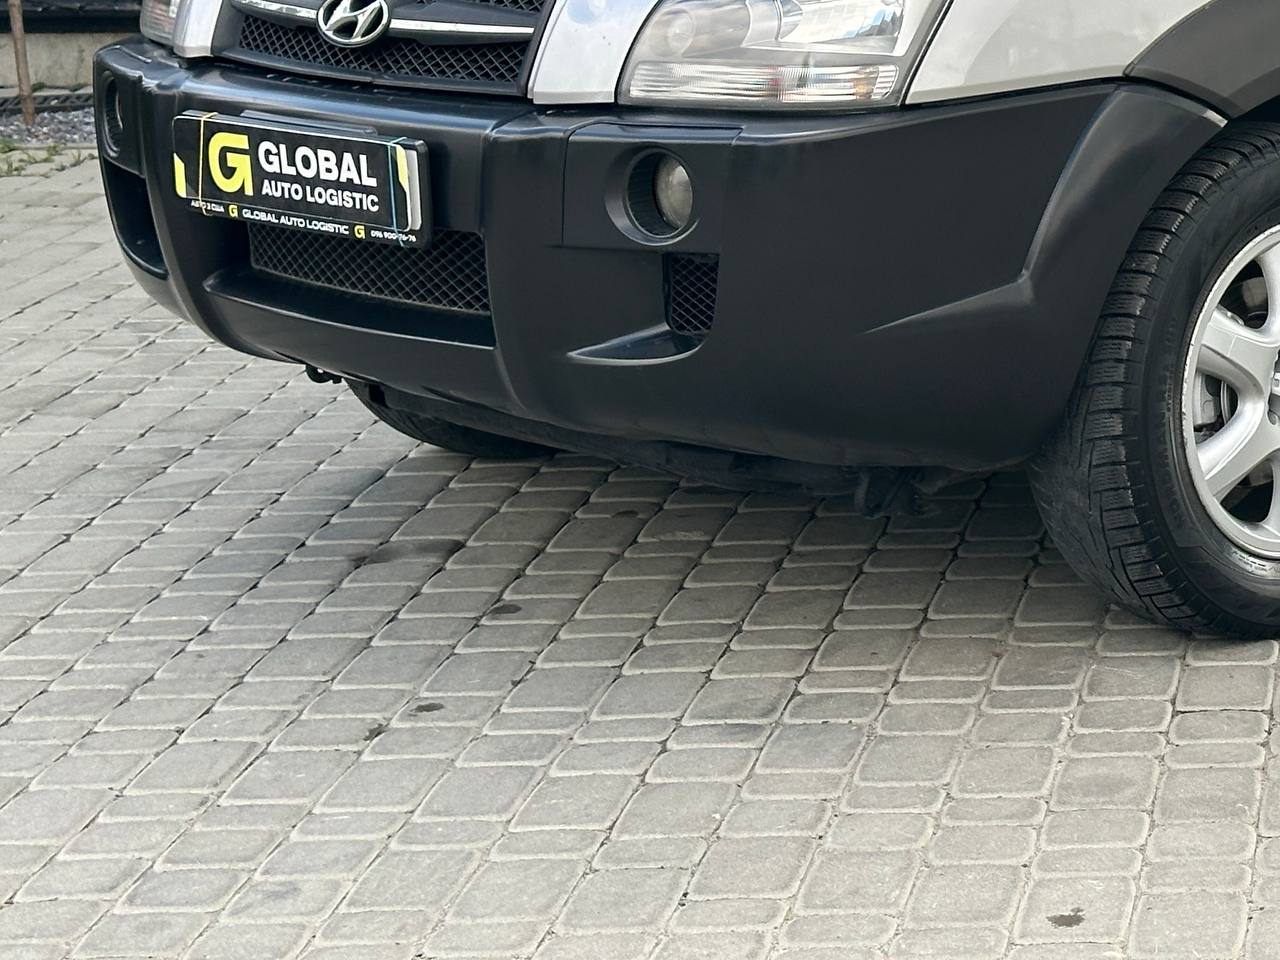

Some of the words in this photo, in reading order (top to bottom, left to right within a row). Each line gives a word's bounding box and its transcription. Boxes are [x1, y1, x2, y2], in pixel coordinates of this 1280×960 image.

[207, 131, 254, 197] G
[258, 140, 378, 187] GLOBAL
[262, 179, 303, 202] AUTO
[306, 186, 380, 213] LOGISTIC
[242, 208, 279, 223] GLOBAL
[279, 215, 306, 229] AUTO
[306, 219, 350, 235] LOGISTIC
